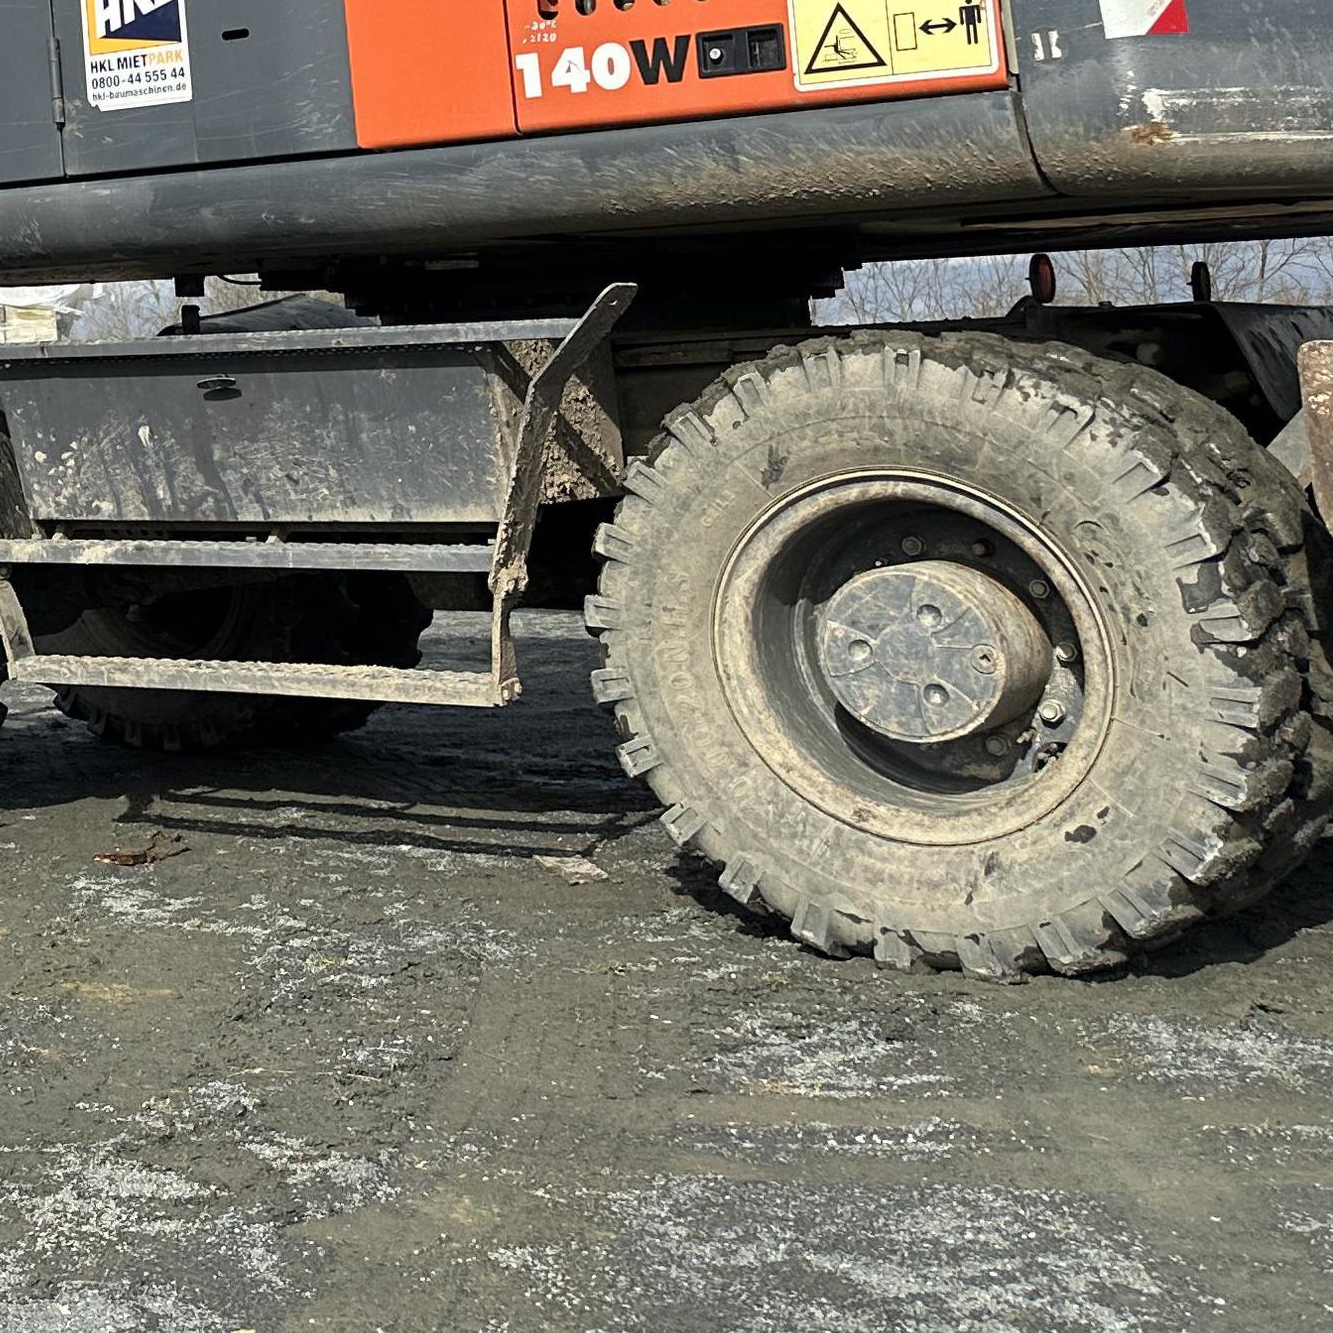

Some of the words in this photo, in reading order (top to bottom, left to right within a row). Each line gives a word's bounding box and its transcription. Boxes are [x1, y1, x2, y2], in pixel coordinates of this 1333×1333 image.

[90, 59, 115, 74] HKL
[117, 49, 184, 71] MIETPARK
[145, 69, 167, 83] 555
[171, 66, 185, 79] 44
